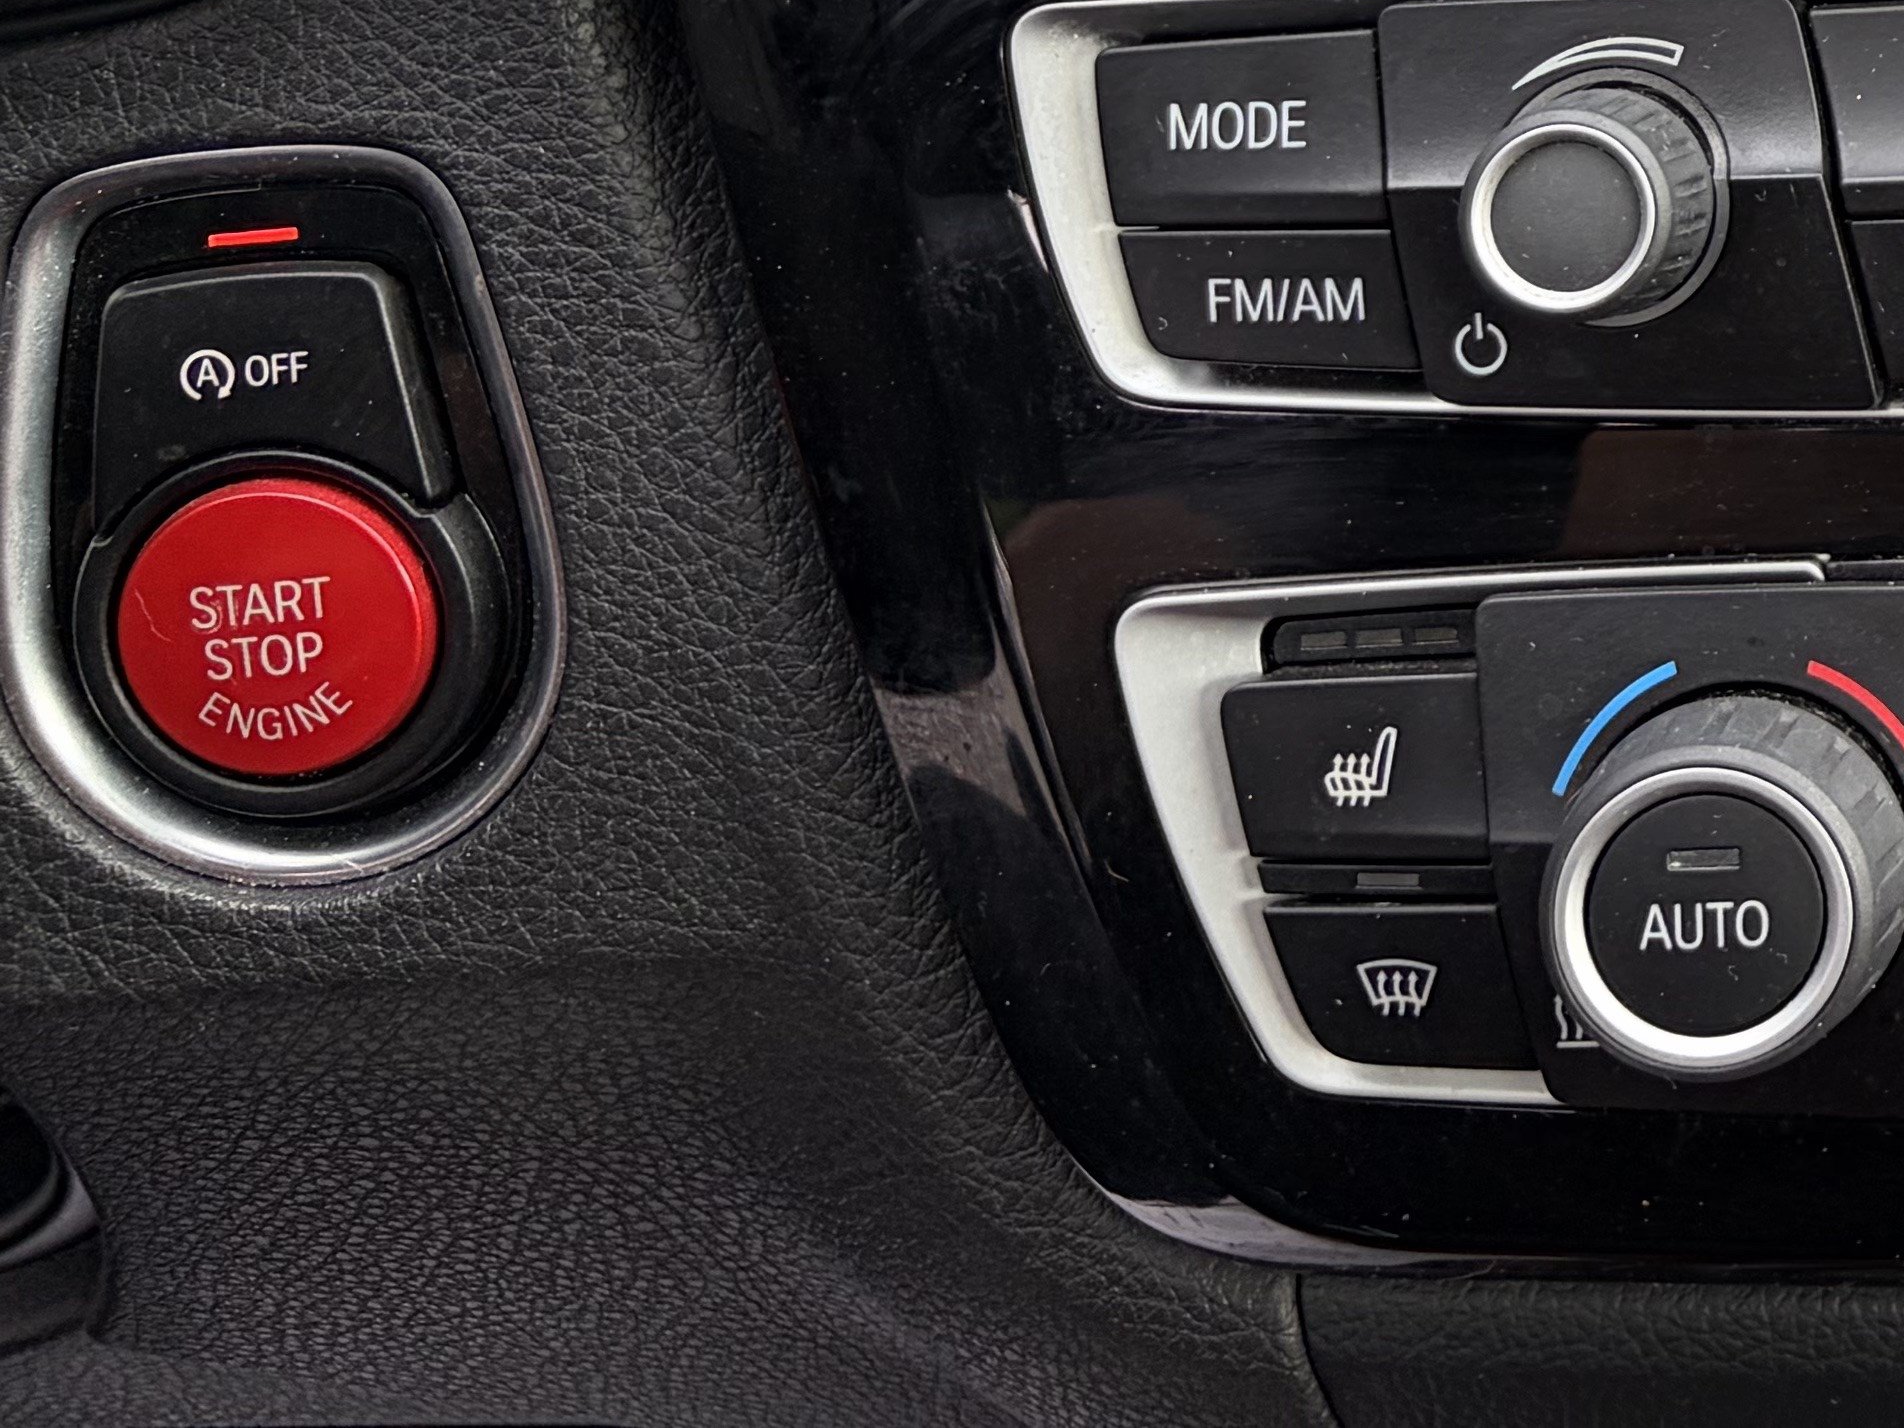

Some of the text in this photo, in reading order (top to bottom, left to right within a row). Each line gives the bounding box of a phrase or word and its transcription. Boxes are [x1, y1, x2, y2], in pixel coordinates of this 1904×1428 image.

[1169, 101, 1307, 149] MODE
[1208, 278, 1366, 323] FM/AM
[245, 351, 308, 387] OFF
[190, 576, 330, 629] START
[205, 632, 323, 681] STOP
[199, 681, 353, 740] ENGINE
[1640, 900, 1769, 950] AUTO
